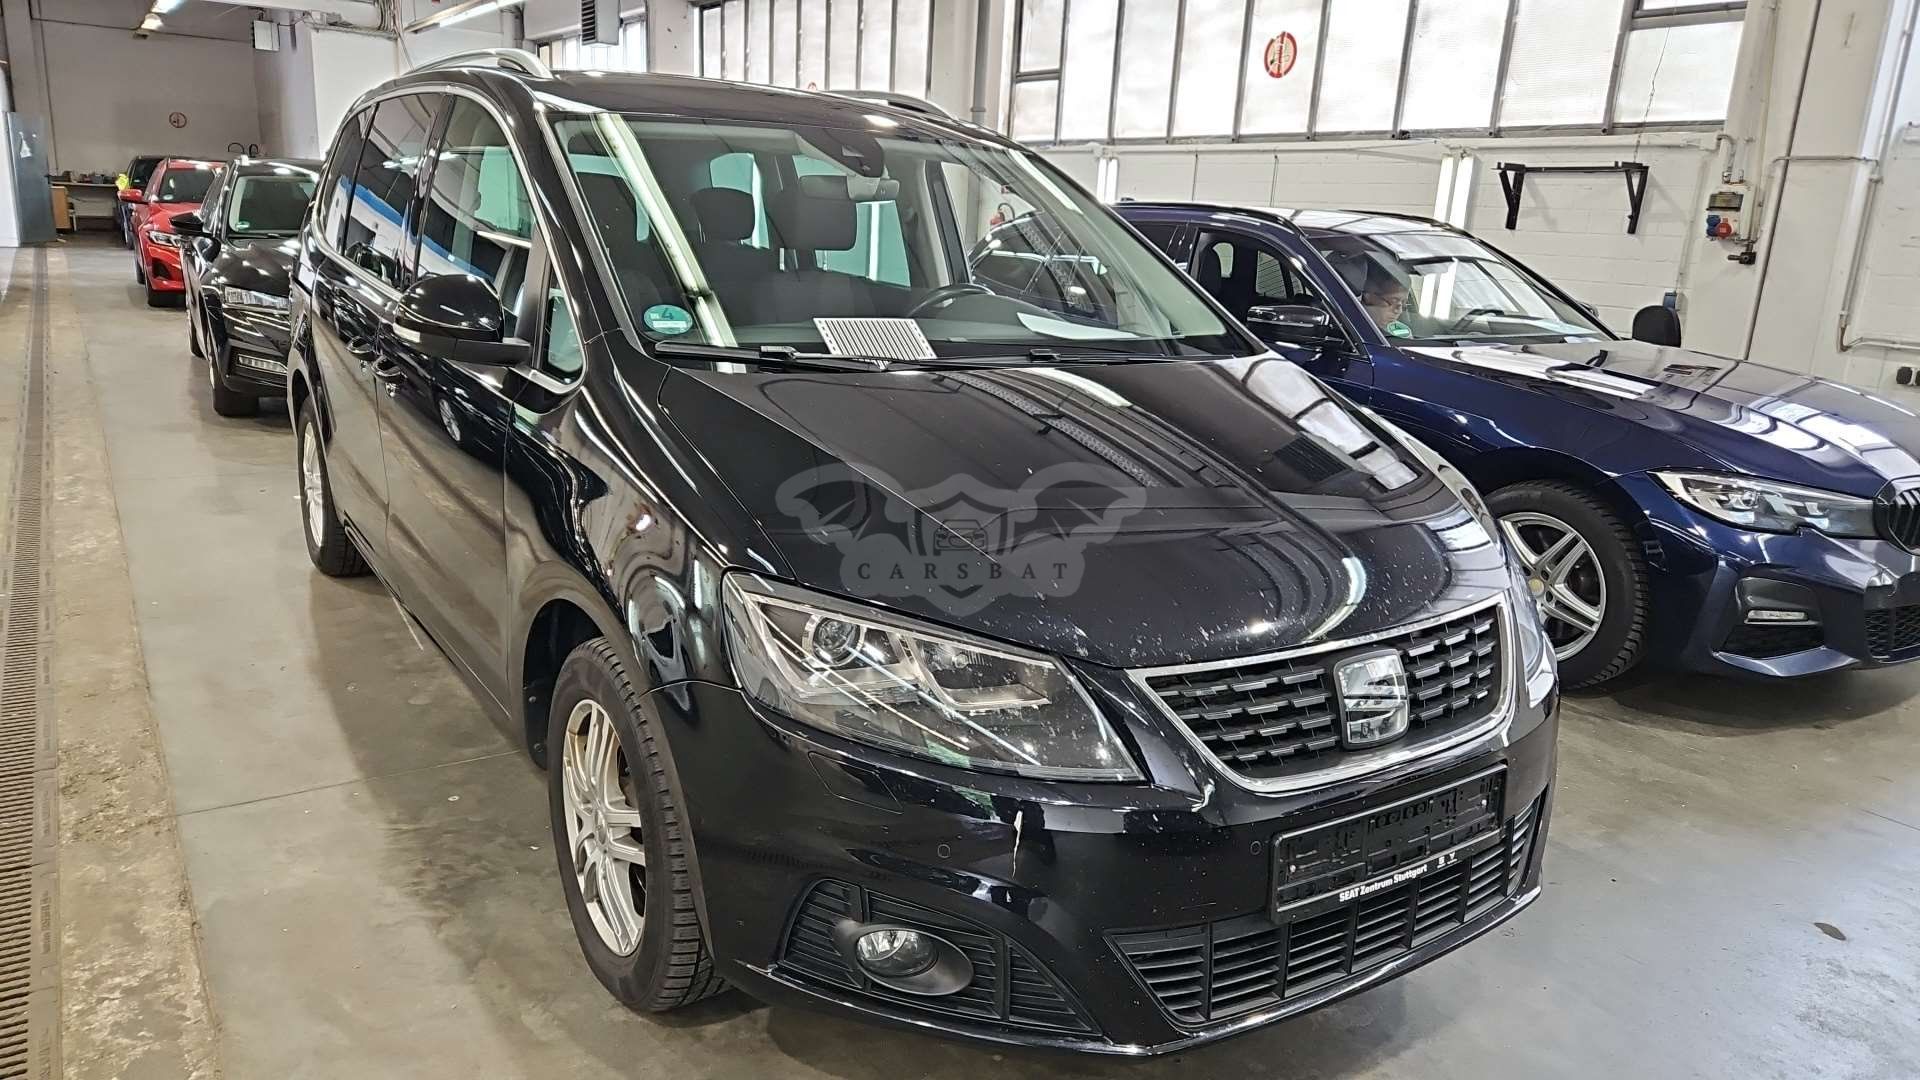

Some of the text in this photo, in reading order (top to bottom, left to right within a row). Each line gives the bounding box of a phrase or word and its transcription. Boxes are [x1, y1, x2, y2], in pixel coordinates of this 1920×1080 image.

[1339, 887, 1360, 902] SEAT
[1360, 879, 1393, 895] Zentrum
[1393, 864, 1427, 883] Stuttgart
